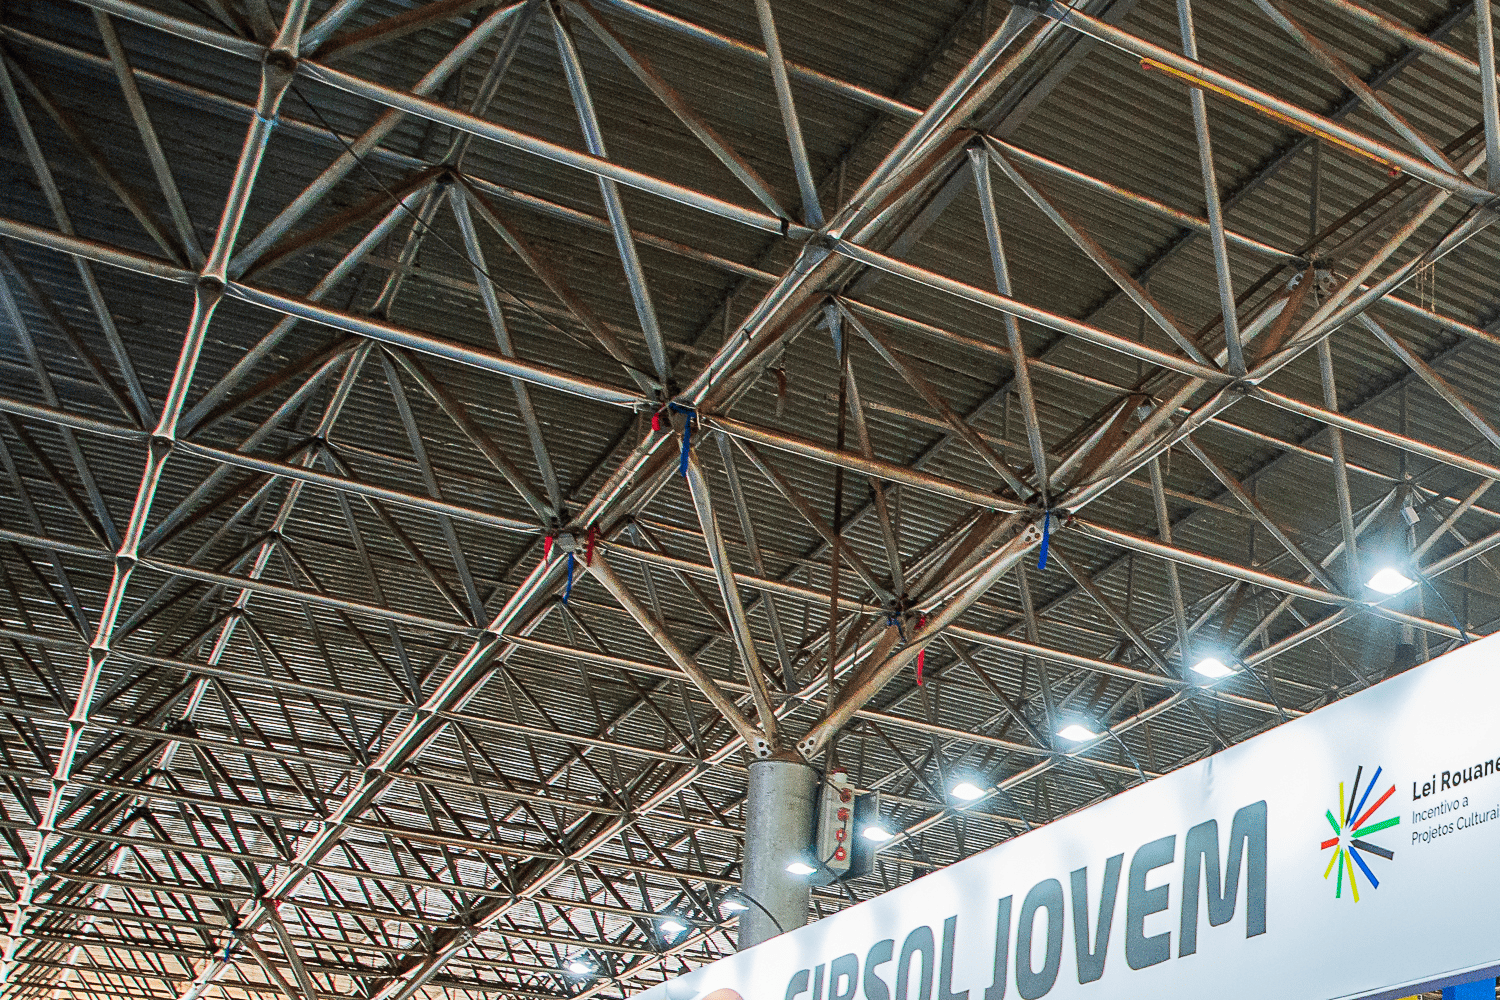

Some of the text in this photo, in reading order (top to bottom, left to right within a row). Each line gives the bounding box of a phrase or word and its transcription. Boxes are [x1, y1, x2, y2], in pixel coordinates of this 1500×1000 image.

[1412, 774, 1436, 801] Lei
[1412, 796, 1469, 824] Incentivo a
[1411, 820, 1454, 845] Projetos
